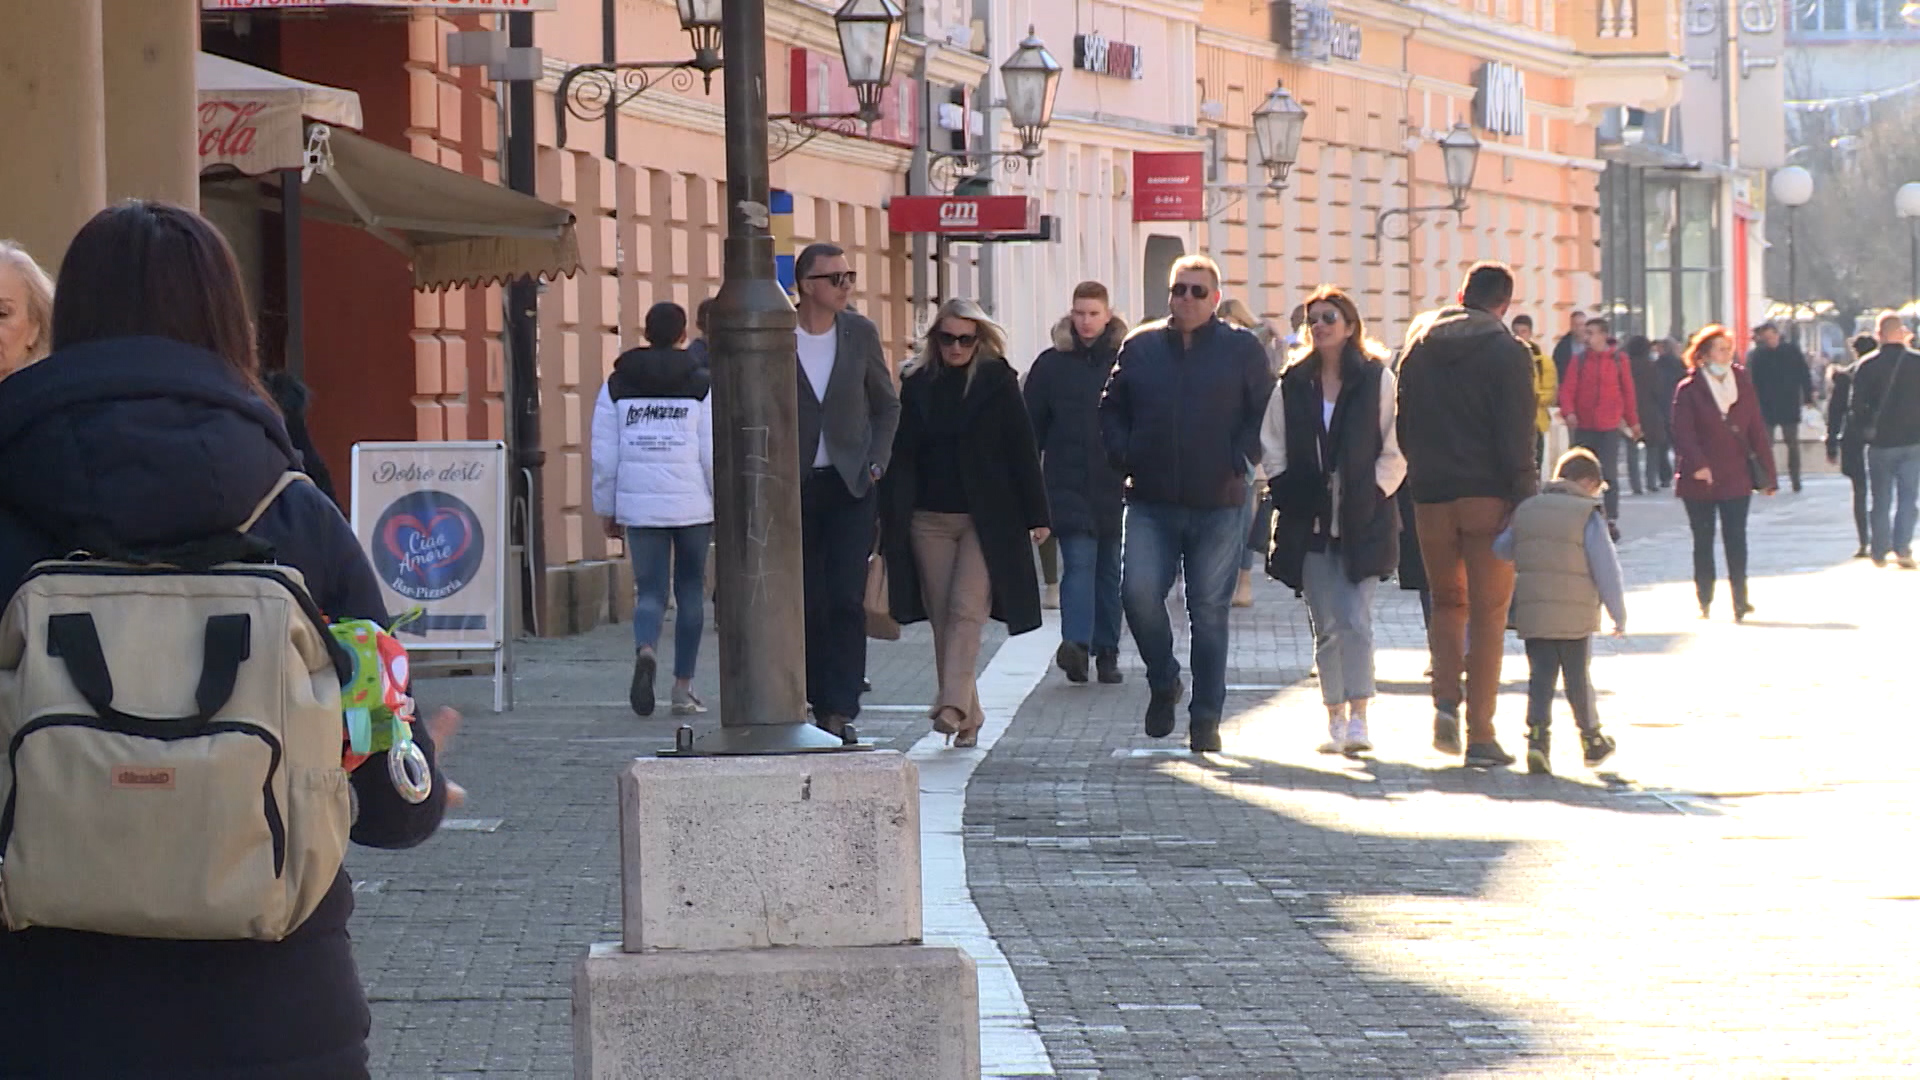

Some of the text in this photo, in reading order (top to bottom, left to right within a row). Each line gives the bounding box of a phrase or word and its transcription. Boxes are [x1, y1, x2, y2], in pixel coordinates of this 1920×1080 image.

[940, 202, 979, 219] cm
[373, 461, 433, 484] Dobro
[409, 531, 447, 554] Ciao
[399, 546, 452, 575] Amore
